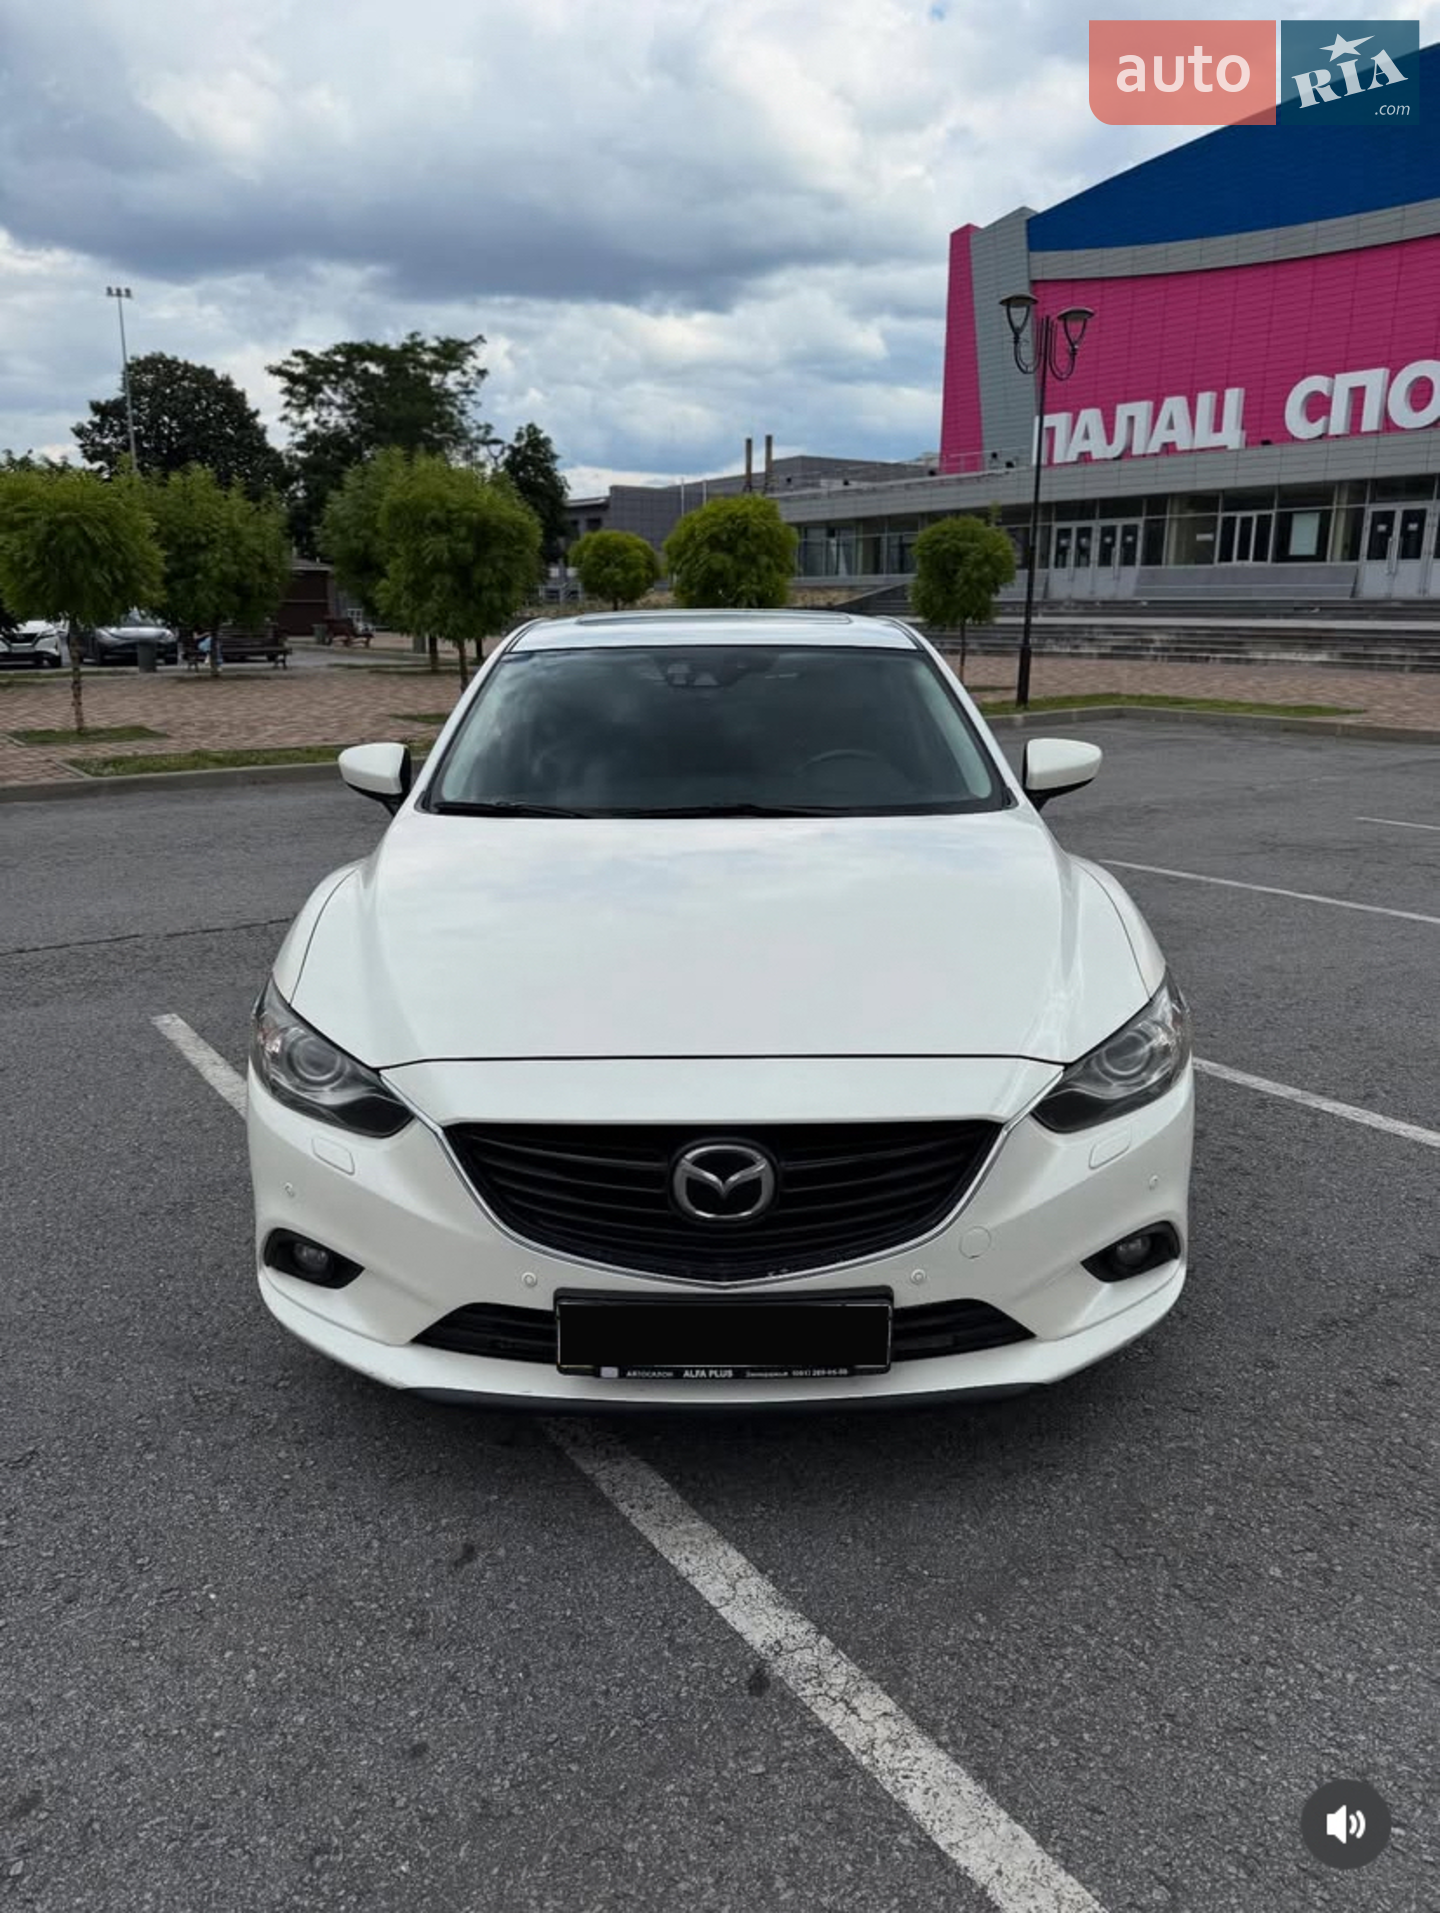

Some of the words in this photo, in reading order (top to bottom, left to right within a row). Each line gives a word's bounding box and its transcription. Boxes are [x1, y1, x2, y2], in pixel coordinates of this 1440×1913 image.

[1032, 388, 1246, 466] ПАЛАЦ
[1285, 359, 1440, 440] СПО
[683, 1369, 706, 1378] ALFA
[709, 1369, 733, 1378] PLUS
